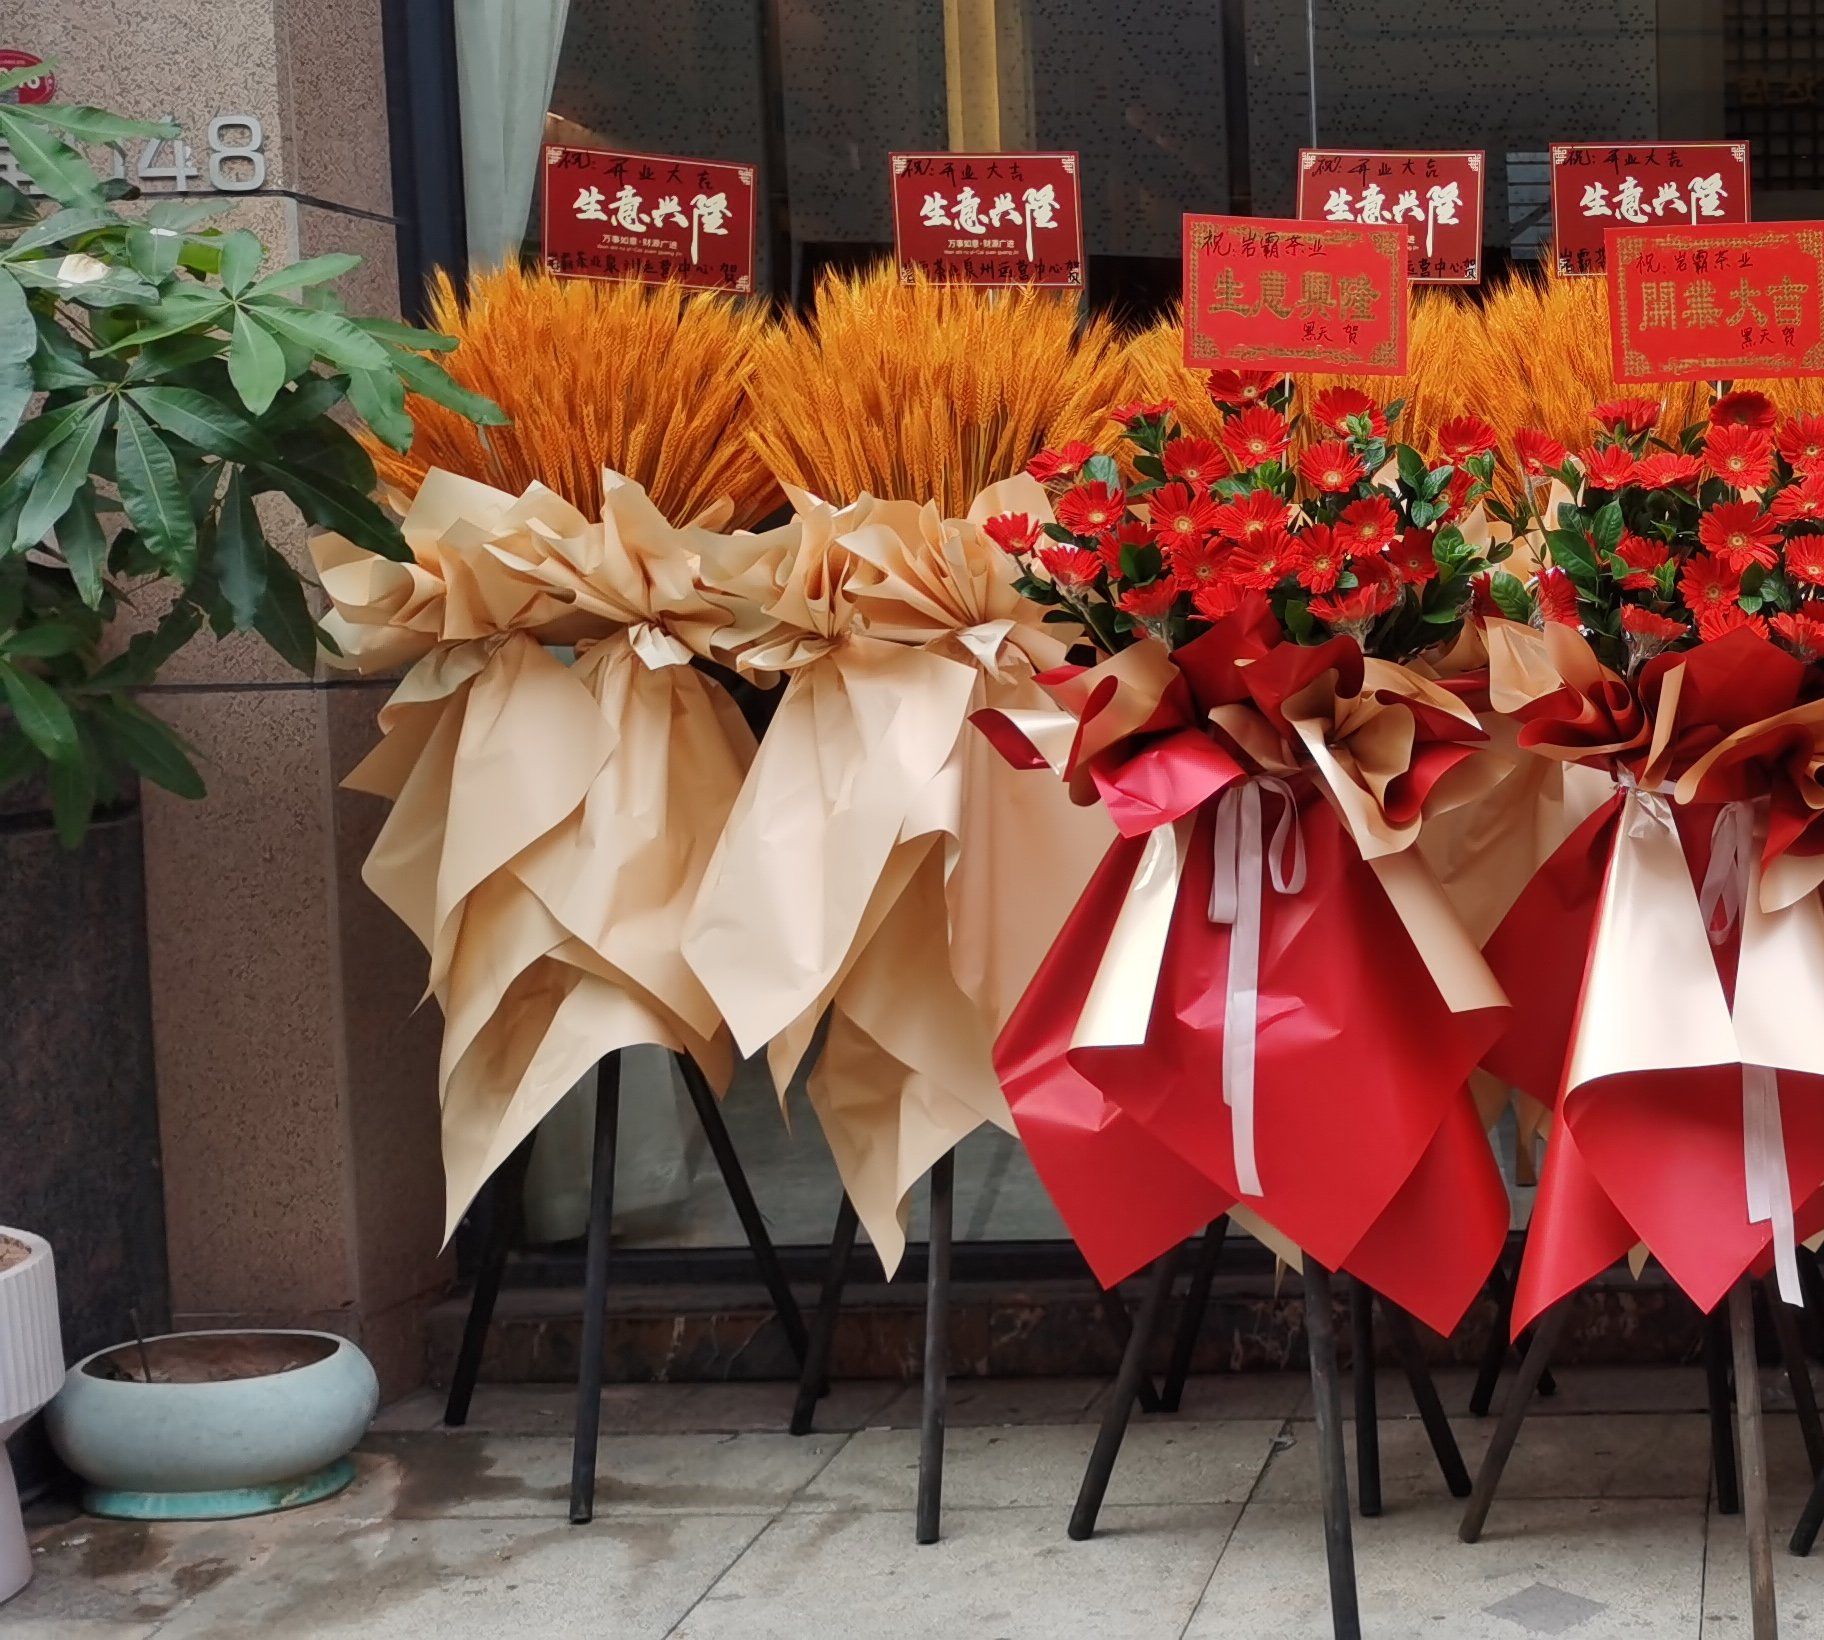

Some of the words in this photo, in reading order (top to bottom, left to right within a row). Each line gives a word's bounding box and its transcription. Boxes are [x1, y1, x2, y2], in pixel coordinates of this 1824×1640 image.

[572, 184, 733, 265] 生意兴隆
[919, 183, 1061, 262] 生意兴隆
[1323, 181, 1464, 258] 生意兴隆
[1579, 172, 1729, 226] 生意兴隆
[1638, 275, 1809, 332] 開業大吉
